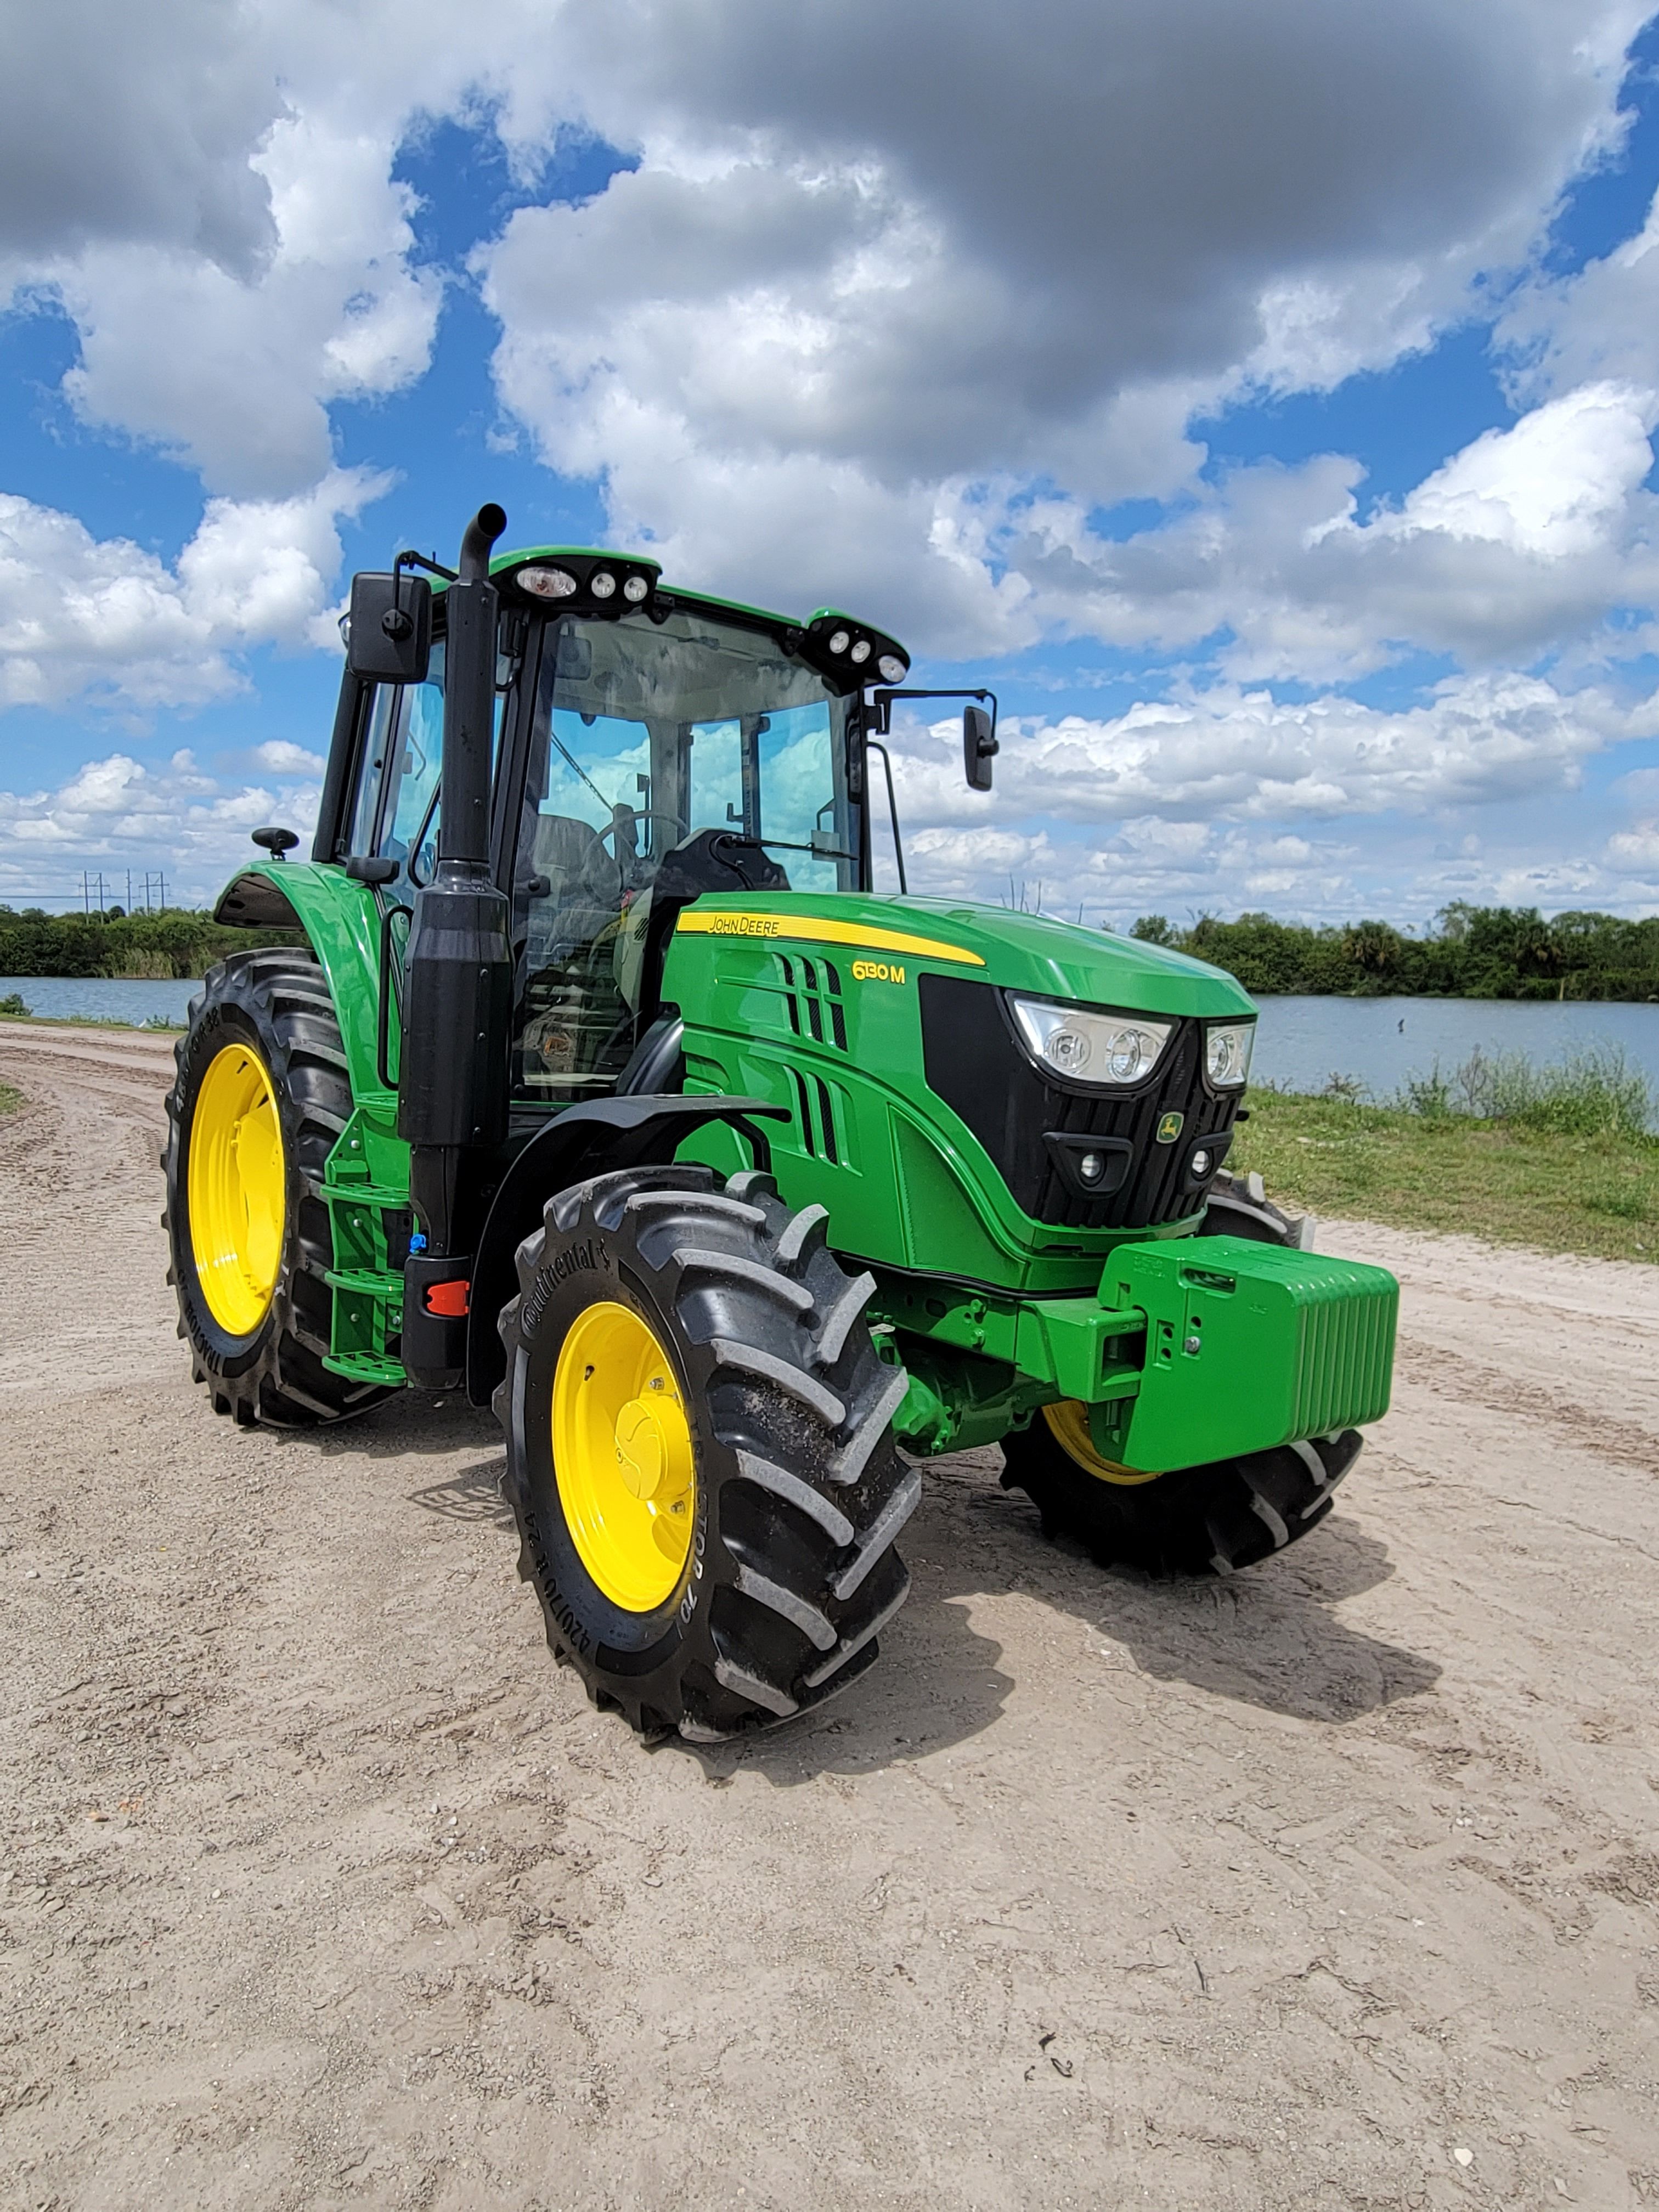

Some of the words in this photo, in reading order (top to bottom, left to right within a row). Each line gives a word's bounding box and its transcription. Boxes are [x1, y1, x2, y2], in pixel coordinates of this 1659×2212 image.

[709, 916, 739, 932] JOHN
[739, 917, 780, 934] DEERE
[521, 1238, 599, 1340] Continental
[544, 1578, 590, 1654] 420/70
[679, 1582, 698, 1625] 70
